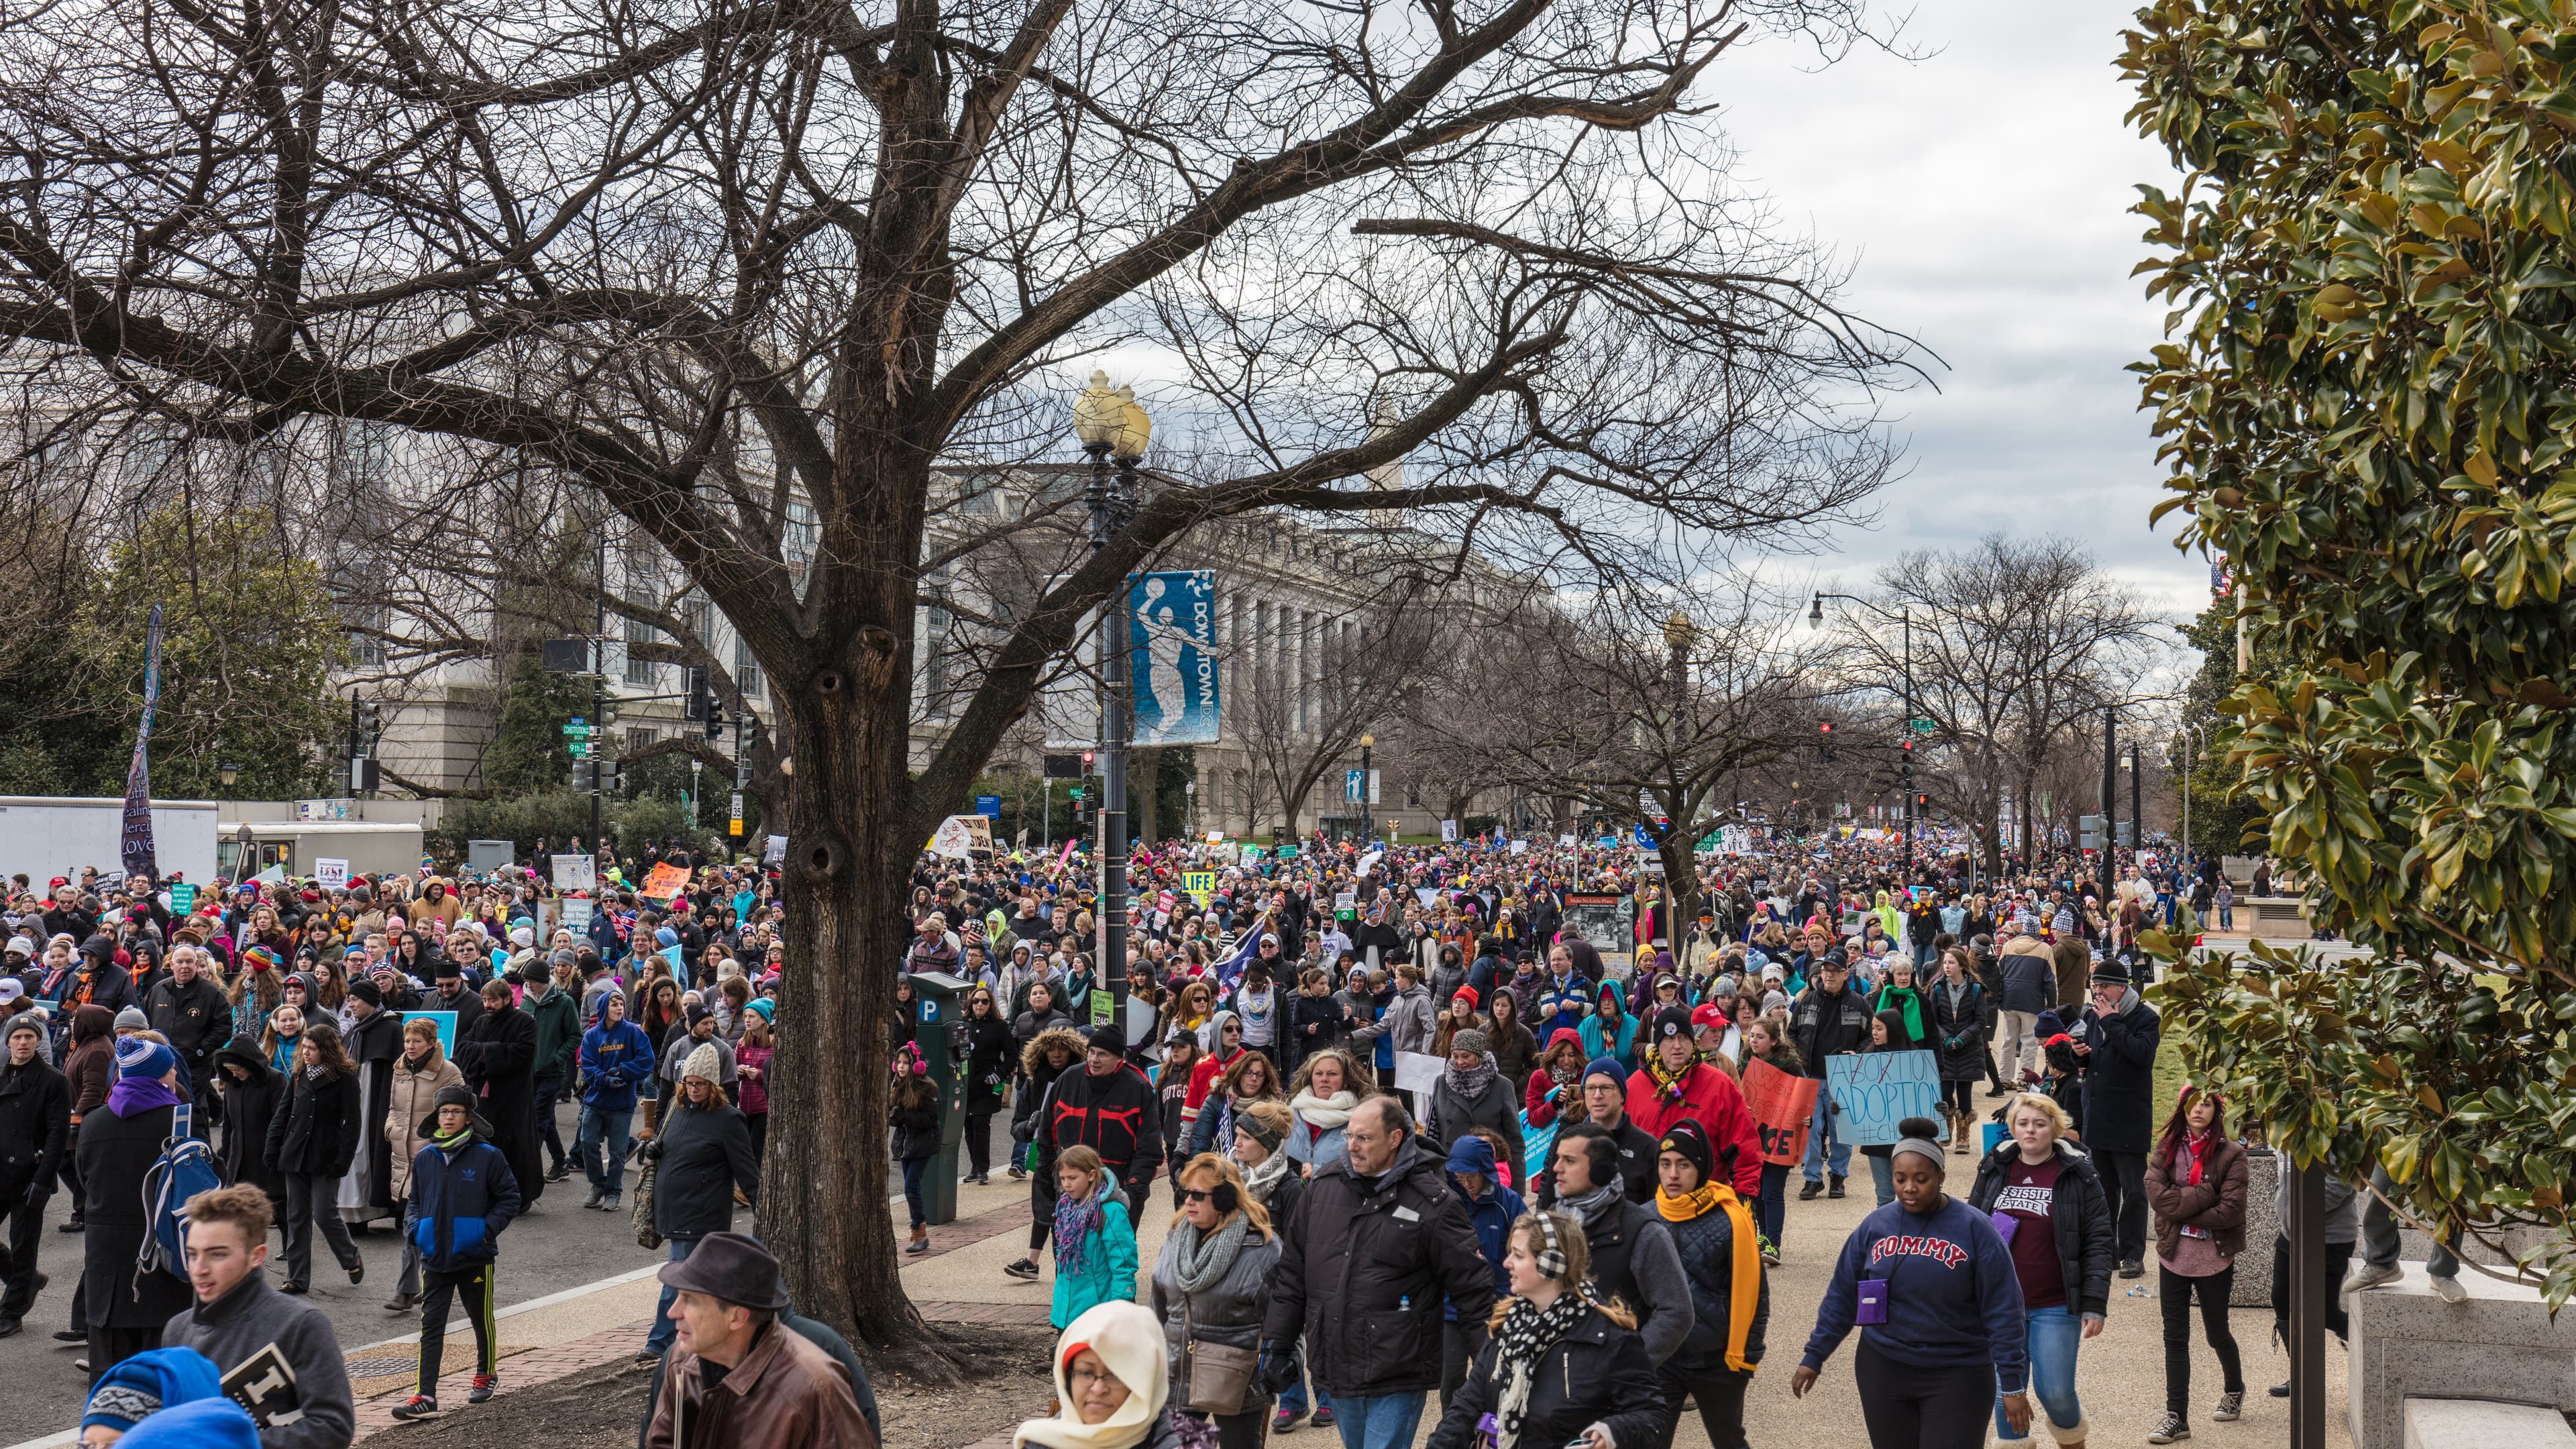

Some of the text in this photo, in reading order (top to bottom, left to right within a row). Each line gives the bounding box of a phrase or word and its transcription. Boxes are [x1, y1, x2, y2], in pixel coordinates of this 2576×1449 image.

[570, 744, 580, 752] 9th
[733, 807, 741, 816] 35
[970, 835, 991, 849] SIDENT
[1183, 874, 1213, 891] LIFE:
[1337, 894, 1353, 902] CHOOSE
[566, 904, 589, 912] Babies
[558, 918, 568, 926] joy
[924, 1000, 936, 1021] P
[1830, 1051, 1940, 1086] ABORTION
[1162, 1083, 1188, 1104] RUTGE
[1835, 1082, 1944, 1125] ADOPTION
[1536, 1123, 1556, 1139] abortion
[1537, 1134, 1550, 1146] heart
[2002, 1199, 2039, 1213] STATE
[1872, 1235, 1968, 1269] TOMMY
